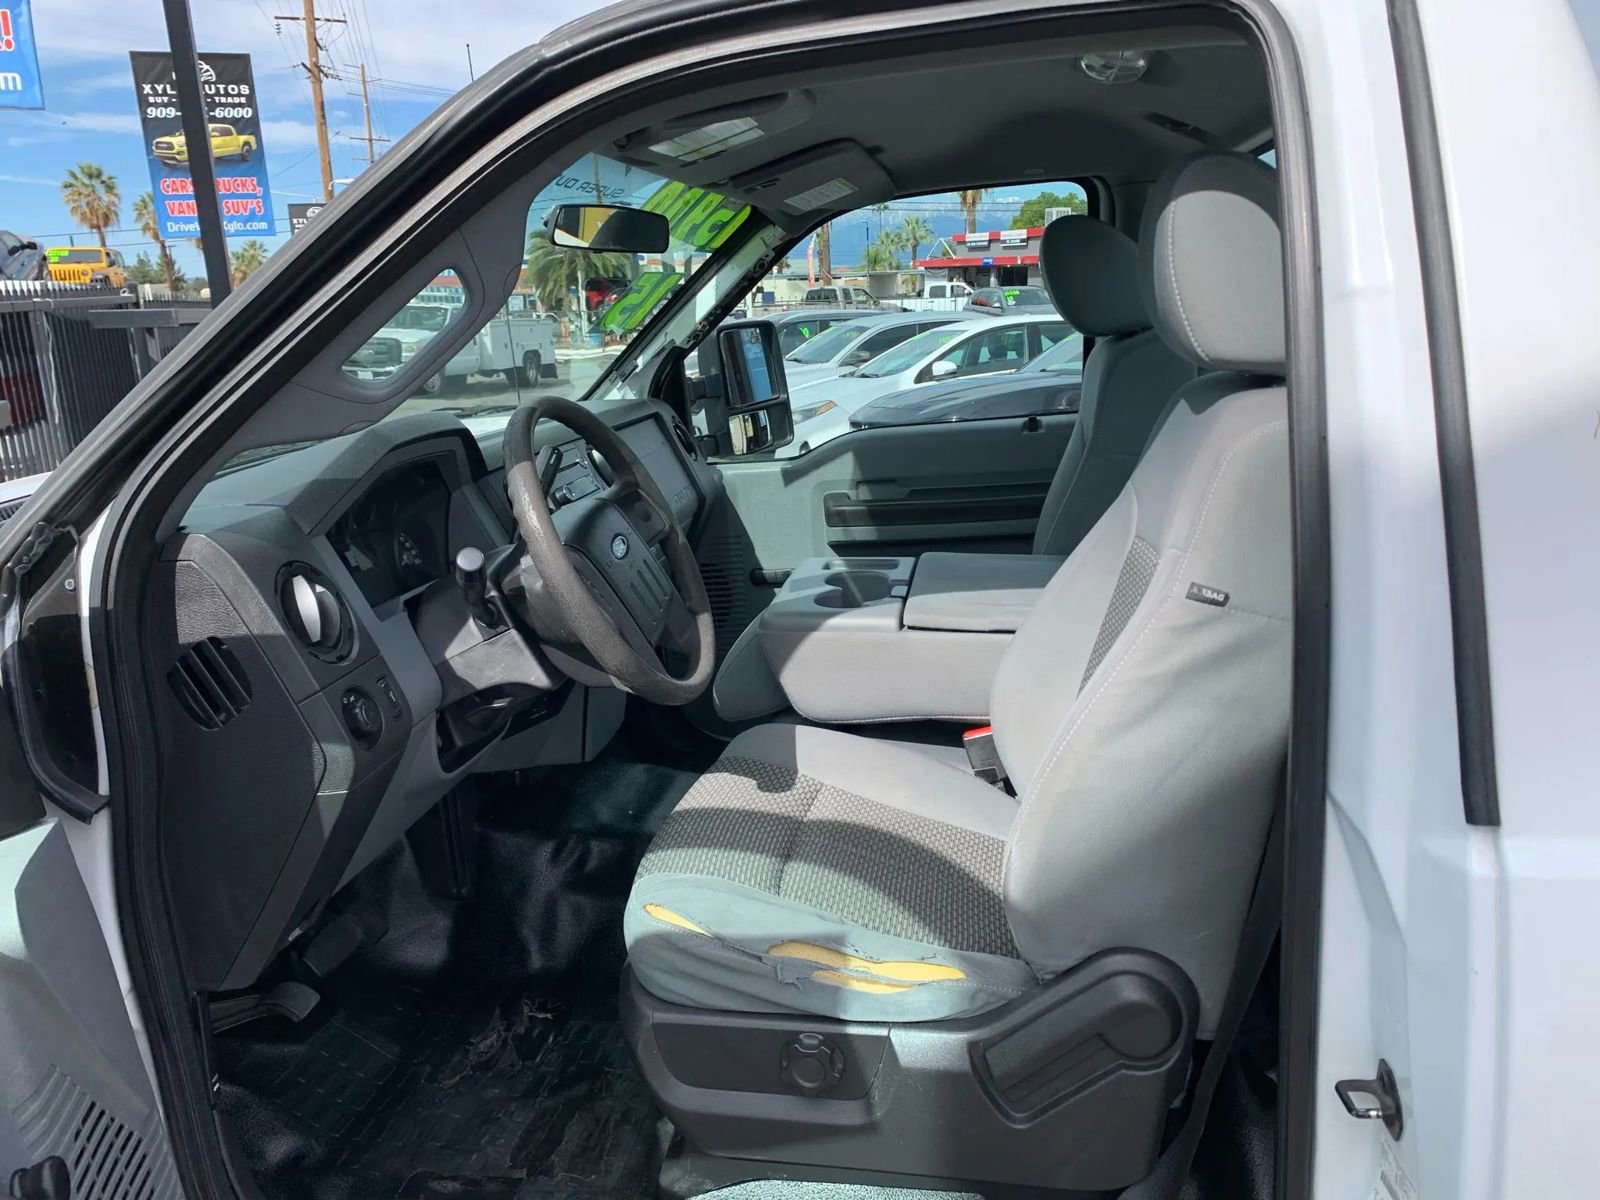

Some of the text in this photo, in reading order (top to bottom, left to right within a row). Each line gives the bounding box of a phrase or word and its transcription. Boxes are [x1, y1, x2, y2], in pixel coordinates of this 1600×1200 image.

[142, 84, 250, 95] XYL UTOS
[148, 96, 247, 104] BUY TRADE
[215, 177, 263, 196] RUCKS,
[165, 199, 264, 217] VAN SUV'S
